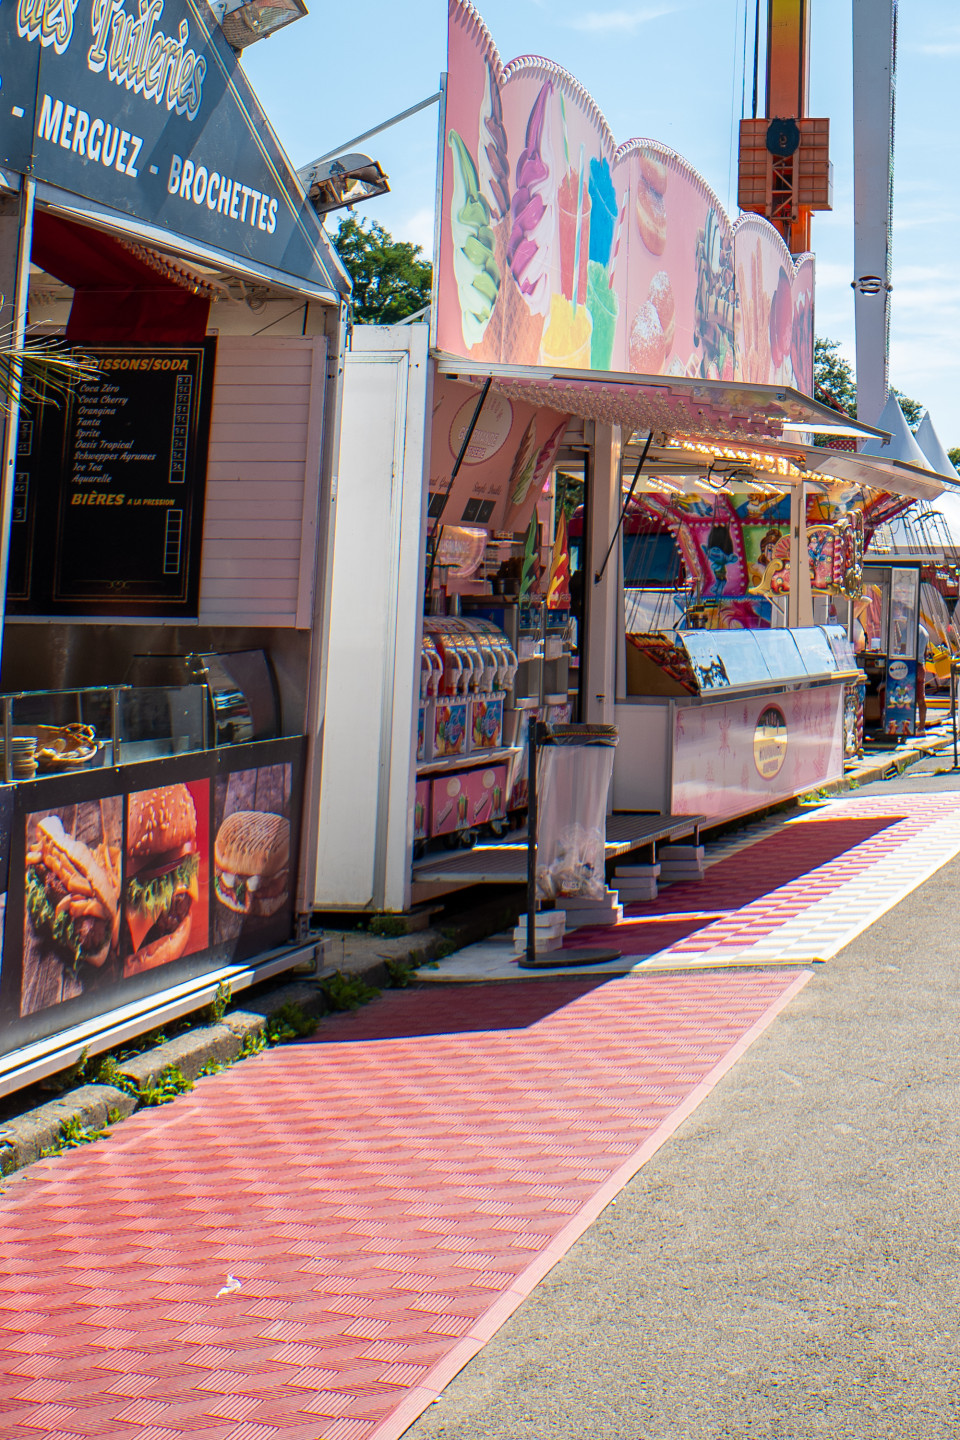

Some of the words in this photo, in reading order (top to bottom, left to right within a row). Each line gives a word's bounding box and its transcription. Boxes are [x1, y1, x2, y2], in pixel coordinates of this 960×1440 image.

[38, 94, 143, 177] MERGUEZ
[168, 154, 279, 234] BROCHETTES
[80, 383, 99, 393] Coca
[100, 383, 120, 393] Zéro
[80, 395, 98, 404] Coca
[100, 394, 128, 406] Cherry
[77, 405, 116, 417] Orangina
[77, 417, 101, 426] Fanta
[76, 428, 101, 440] Sprite
[75, 439, 97, 449] Oasis
[99, 439, 134, 451] Tropical
[73, 450, 119, 462] Schweppes
[120, 451, 157, 462] Agrumes
[73, 462, 86, 471] Ice
[88, 462, 103, 471] Tea
[71, 473, 112, 485] Aquarelle
[71, 490, 125, 505] BIÈRES
[143, 498, 176, 506] PRESSION
